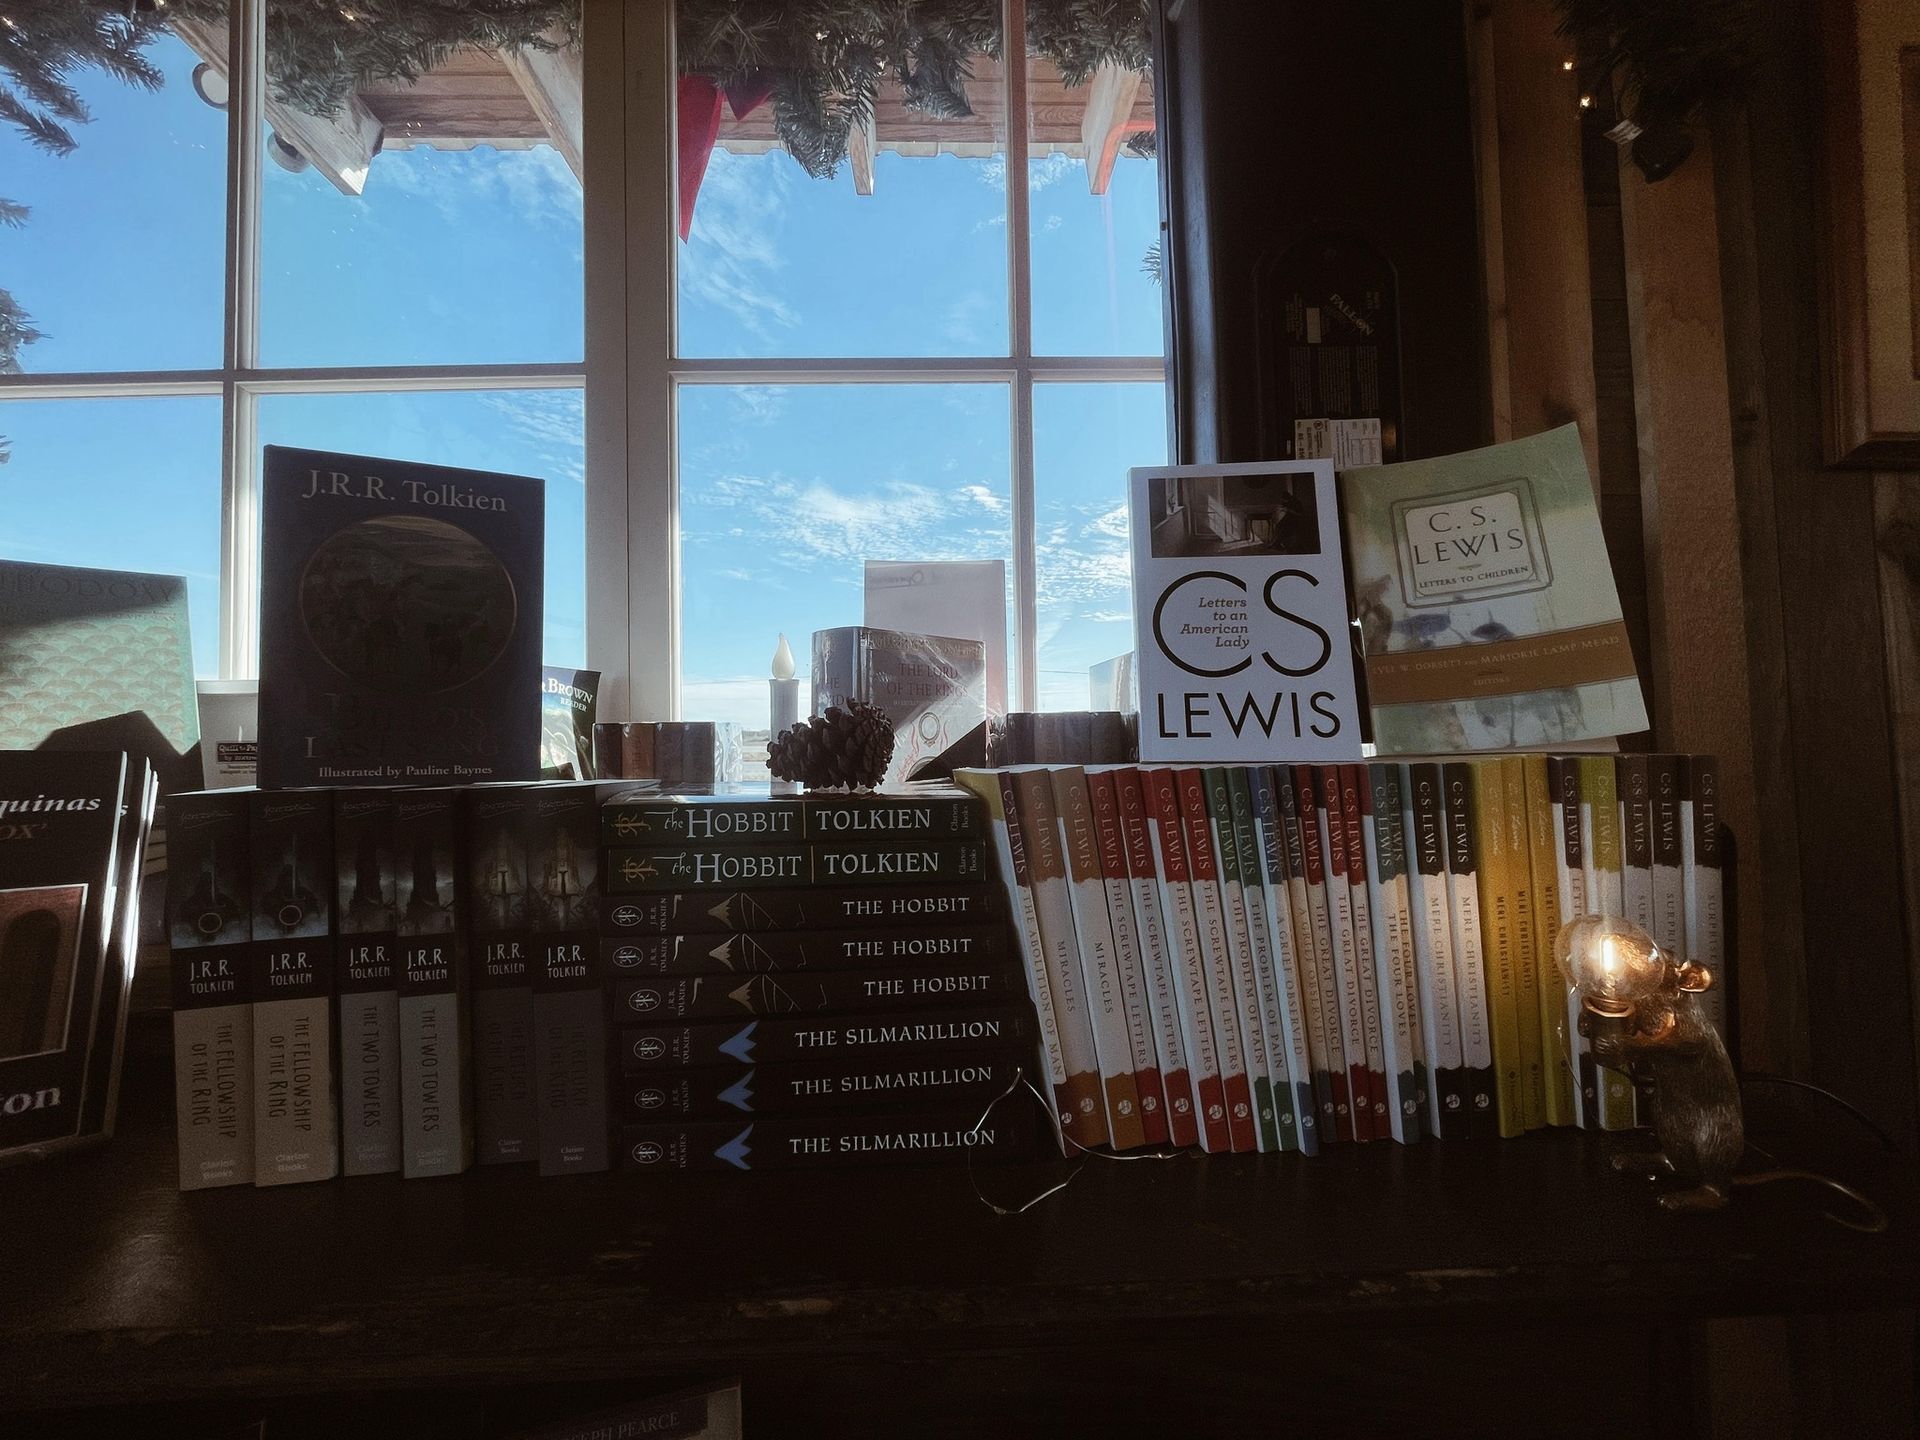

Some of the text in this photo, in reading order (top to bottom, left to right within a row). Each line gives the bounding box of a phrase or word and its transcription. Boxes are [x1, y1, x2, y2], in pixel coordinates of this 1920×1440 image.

[302, 469, 507, 512] J.R.R. Tolkien
[1429, 506, 1496, 532] C. S.
[1413, 528, 1523, 565] LEWIS
[1419, 578, 1457, 588] LETTERS
[1478, 566, 1528, 580] CHILDREN
[1199, 596, 1247, 610] Letters
[1213, 611, 1248, 621] to an
[1180, 623, 1249, 636] American
[1215, 636, 1249, 650] Lady
[1544, 643, 1577, 656] LAMP
[898, 663, 958, 679] THE LORD
[548, 678, 593, 704] BROWN
[886, 683, 968, 697] OF THE RINGS
[560, 697, 587, 712] READER
[1158, 691, 1340, 738] LEWIS
[319, 765, 493, 779] Illustrated by Pauline Baynes
[686, 809, 793, 838] HOBBIT
[816, 808, 931, 831] TOLKIEN
[694, 853, 802, 883] HOBBIT
[824, 852, 940, 874] TOLKIEN
[843, 896, 970, 916] THE HOBBIT
[349, 945, 391, 968] J.R.R.
[407, 948, 447, 969] J.R.R.
[487, 943, 525, 962] J.R.R.
[546, 945, 586, 967] J.R.R.
[843, 938, 972, 957] THE HOBBIT
[190, 959, 234, 982] J.R.R.
[270, 952, 313, 973] J.R.R.
[349, 966, 391, 980] TOLKIEN
[408, 968, 448, 983] TOLKIEN
[488, 963, 525, 976] TOLKIEN
[547, 965, 586, 979] TOLKIEN
[1029, 932, 1050, 1012] ABOLITION
[1113, 883, 1146, 1065] THE SCREWTAPE LETTERS
[1142, 884, 1178, 1066] THE SCREWTAPE LETTERS
[1338, 895, 1360, 1045] THE GREAT DIVORCE
[1389, 914, 1406, 1037] THE FOUR LOVES
[1399, 908, 1416, 1028] THE FOUR LOVES
[1462, 896, 1481, 1046] MERE CHRISTIANITY
[190, 980, 235, 995] TOLKIEN
[270, 974, 313, 987] TOLKIEN
[864, 975, 990, 996] THE HOBBIT
[1057, 942, 1074, 1013] MIRACLES
[1095, 942, 1113, 1014] MIRACLES
[1176, 886, 1213, 1072] THE SCREWTAPE LETTERS
[1204, 885, 1239, 1070] THE SCREWTAPE LETTERS
[1232, 896, 1264, 1064] THE PROBLEM OF PAIN
[1251, 903, 1284, 1068] THE PROBLEM OF PAIN
[1317, 905, 1340, 1053] THE GREAT DIVORCE
[1357, 905, 1378, 1052] THE GREAT DIVORCE
[1279, 931, 1291, 969] GRIEF
[1286, 981, 1303, 1055] OBSERVED
[1433, 940, 1451, 1047] CHRISTIANITY
[795, 1021, 1001, 1048] THE SILMARILLION
[1045, 1019, 1054, 1033] OF
[293, 1016, 312, 1131] THE FELLOWSHIP
[362, 1006, 381, 1128] THE TWO TOWERS
[421, 1009, 439, 1132] THE TWO TOWERS
[1049, 1044, 1062, 1076] MAN
[191, 1042, 212, 1126] OF THE RING
[216, 1023, 236, 1139] THE FELLOWSHIP
[268, 1035, 288, 1118] OF THE RING
[791, 1066, 992, 1096] THE SILMARILLION
[790, 1130, 996, 1154] THE SILMARILLION
